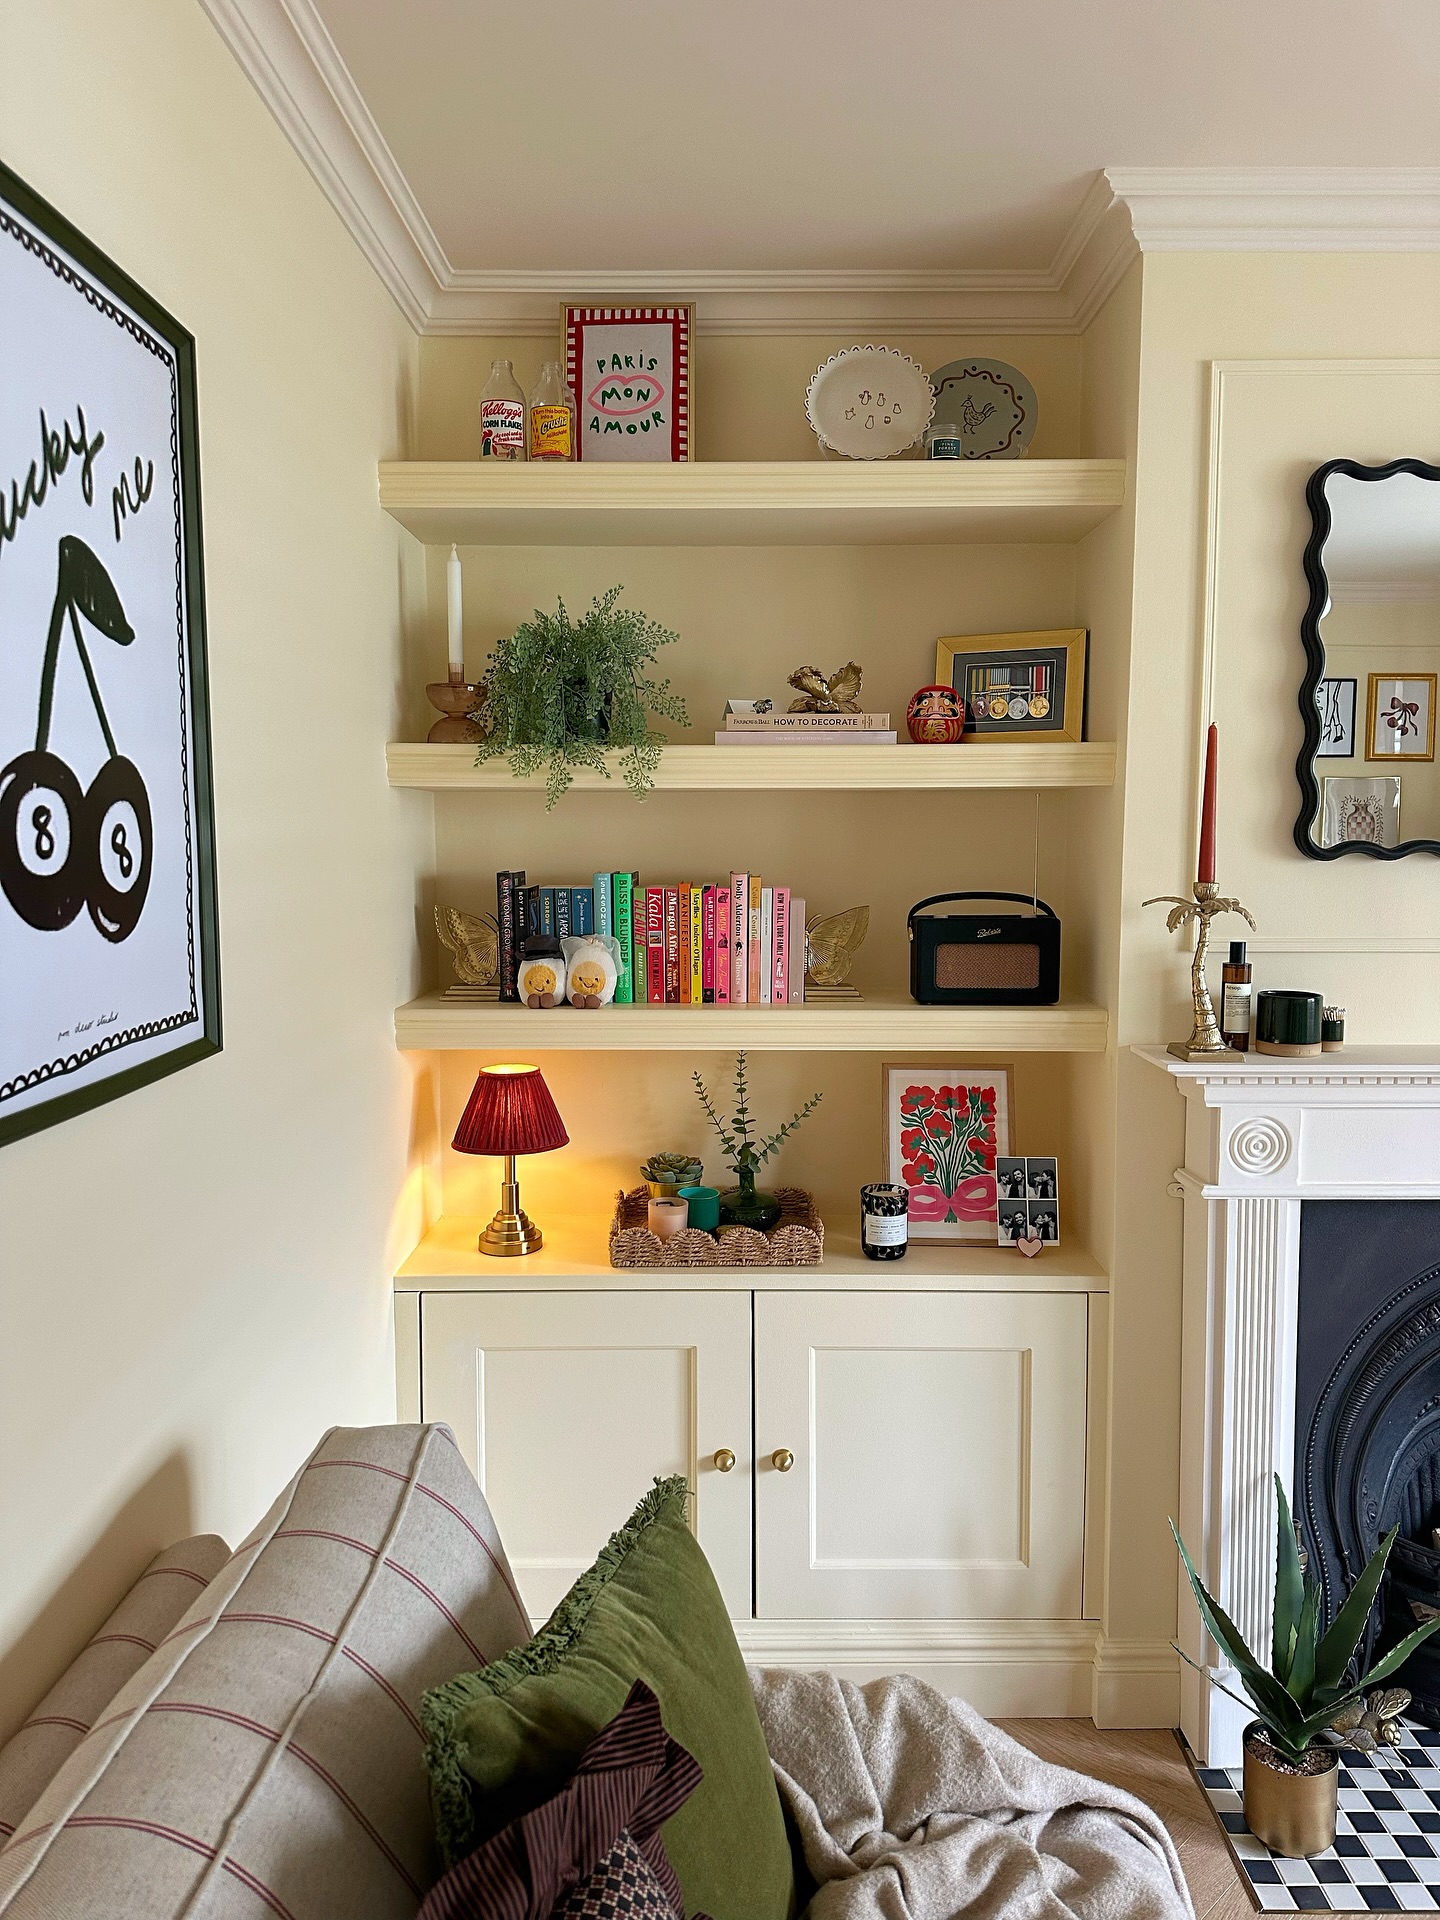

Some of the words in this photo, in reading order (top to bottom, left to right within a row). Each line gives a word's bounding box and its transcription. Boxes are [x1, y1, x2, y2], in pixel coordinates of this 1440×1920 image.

[597, 349, 658, 374] PARIS
[601, 387, 651, 407] MON
[482, 402, 523, 420] Kellogg's
[482, 420, 500, 429] CORN
[501, 420, 523, 431] FLAKES
[541, 416, 568, 435] Crusha
[590, 411, 665, 435] AMOUR
[0, 403, 105, 554] ucky
[112, 456, 154, 543] me
[773, 718, 795, 726] HOW
[797, 718, 809, 726] TO
[811, 718, 858, 726] DECORATE
[32, 805, 55, 860] 8
[111, 823, 133, 878] 8
[502, 879, 511, 896] WHY
[558, 891, 567, 899] MY
[619, 879, 629, 905] BLISS
[734, 879, 743, 901] Dolly
[777, 892, 785, 904] HOW
[557, 898, 569, 906] LOVE
[648, 893, 662, 928] Kala
[750, 886, 759, 913] Colour
[777, 904, 785, 912] TO
[502, 896, 512, 928] WOMEN
[619, 907, 629, 916] &
[634, 899, 646, 947] CLEANER
[667, 897, 677, 931] Margot
[681, 893, 689, 949] MANIFEST
[718, 905, 729, 931] Bunny
[735, 902, 743, 937] Alderton
[777, 912, 785, 924] KILL
[503, 928, 512, 951] GROW
[559, 919, 569, 939] APOCA
[751, 914, 761, 955] Confidence
[777, 924, 785, 938] YOUR
[619, 918, 629, 964] BLUNDER
[668, 932, 678, 962] Affair
[776, 938, 785, 957] FAMILY
[651, 950, 660, 968] COLIN
[692, 948, 700, 976] O'Hagan
[651, 968, 660, 989] WALSH
[734, 957, 743, 985] Ghosts
